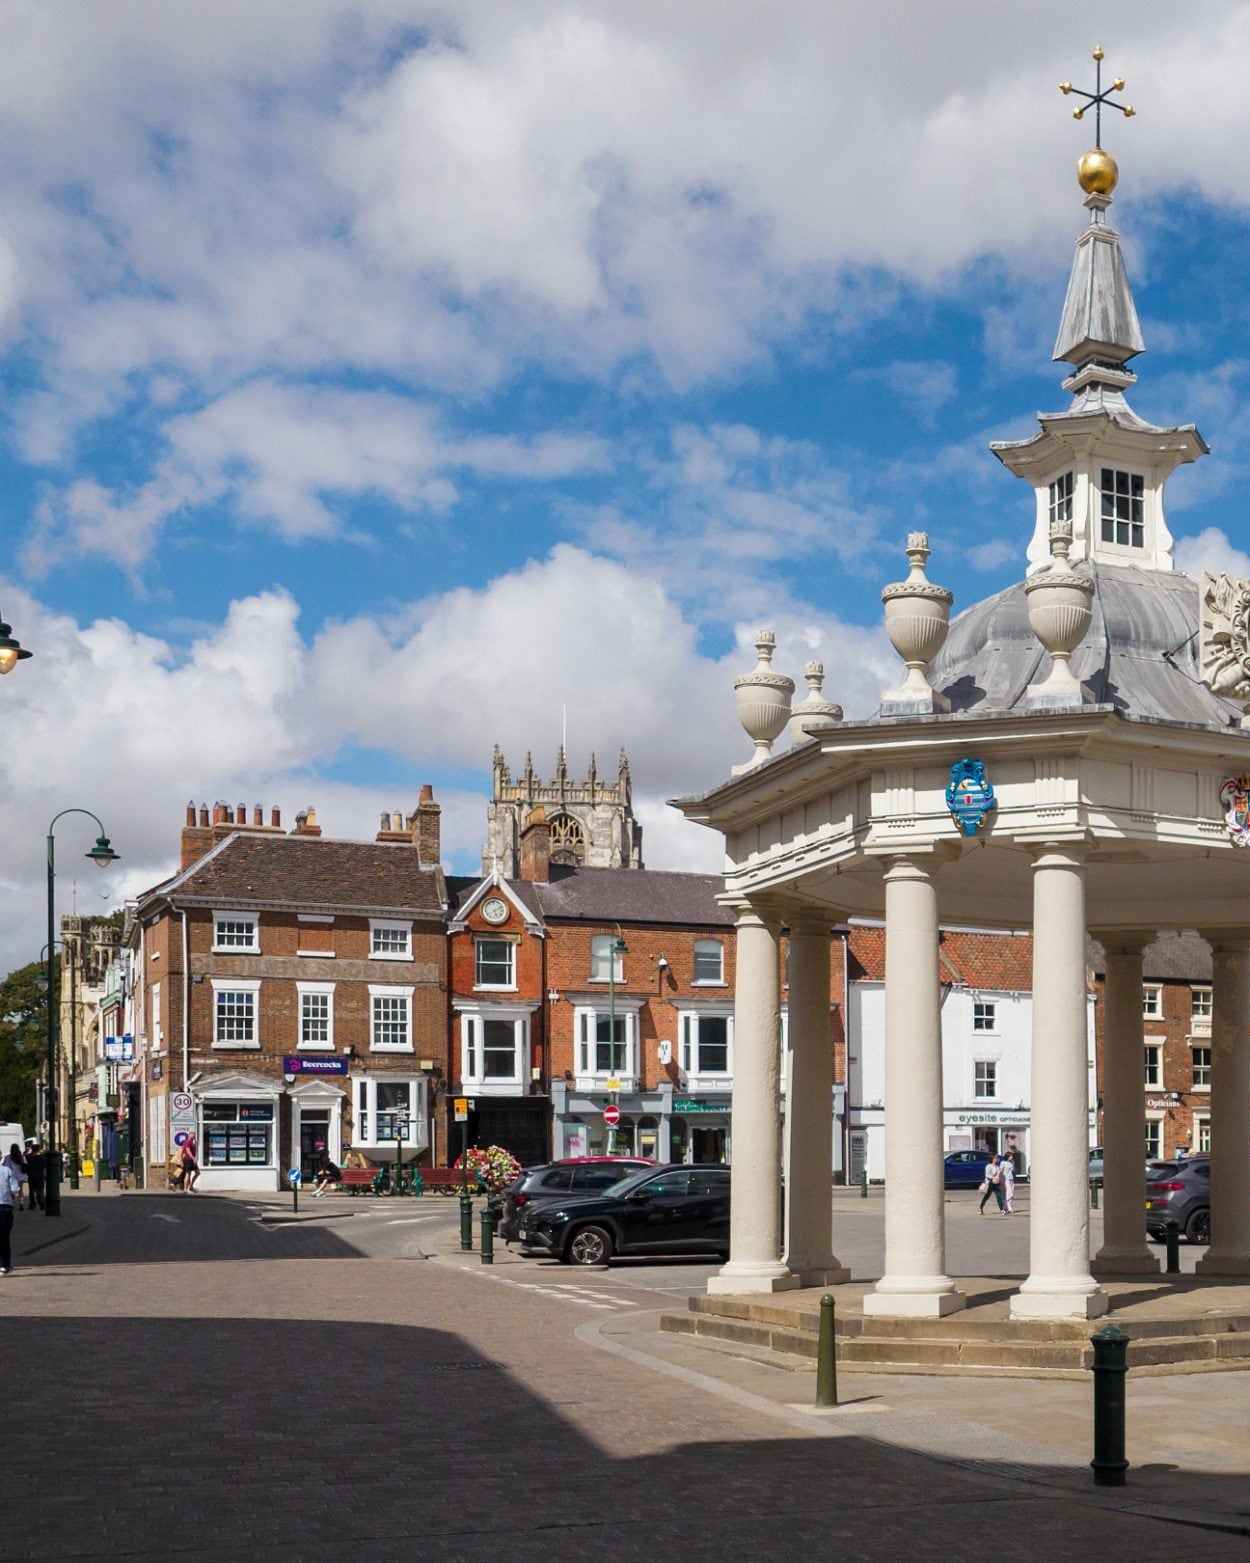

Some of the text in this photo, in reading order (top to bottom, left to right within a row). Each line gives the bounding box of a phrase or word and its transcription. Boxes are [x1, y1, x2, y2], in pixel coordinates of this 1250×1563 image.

[176, 1098, 190, 1106] 30
[1147, 1100, 1181, 1109] Opticians
[959, 1114, 997, 1124] eyesite
